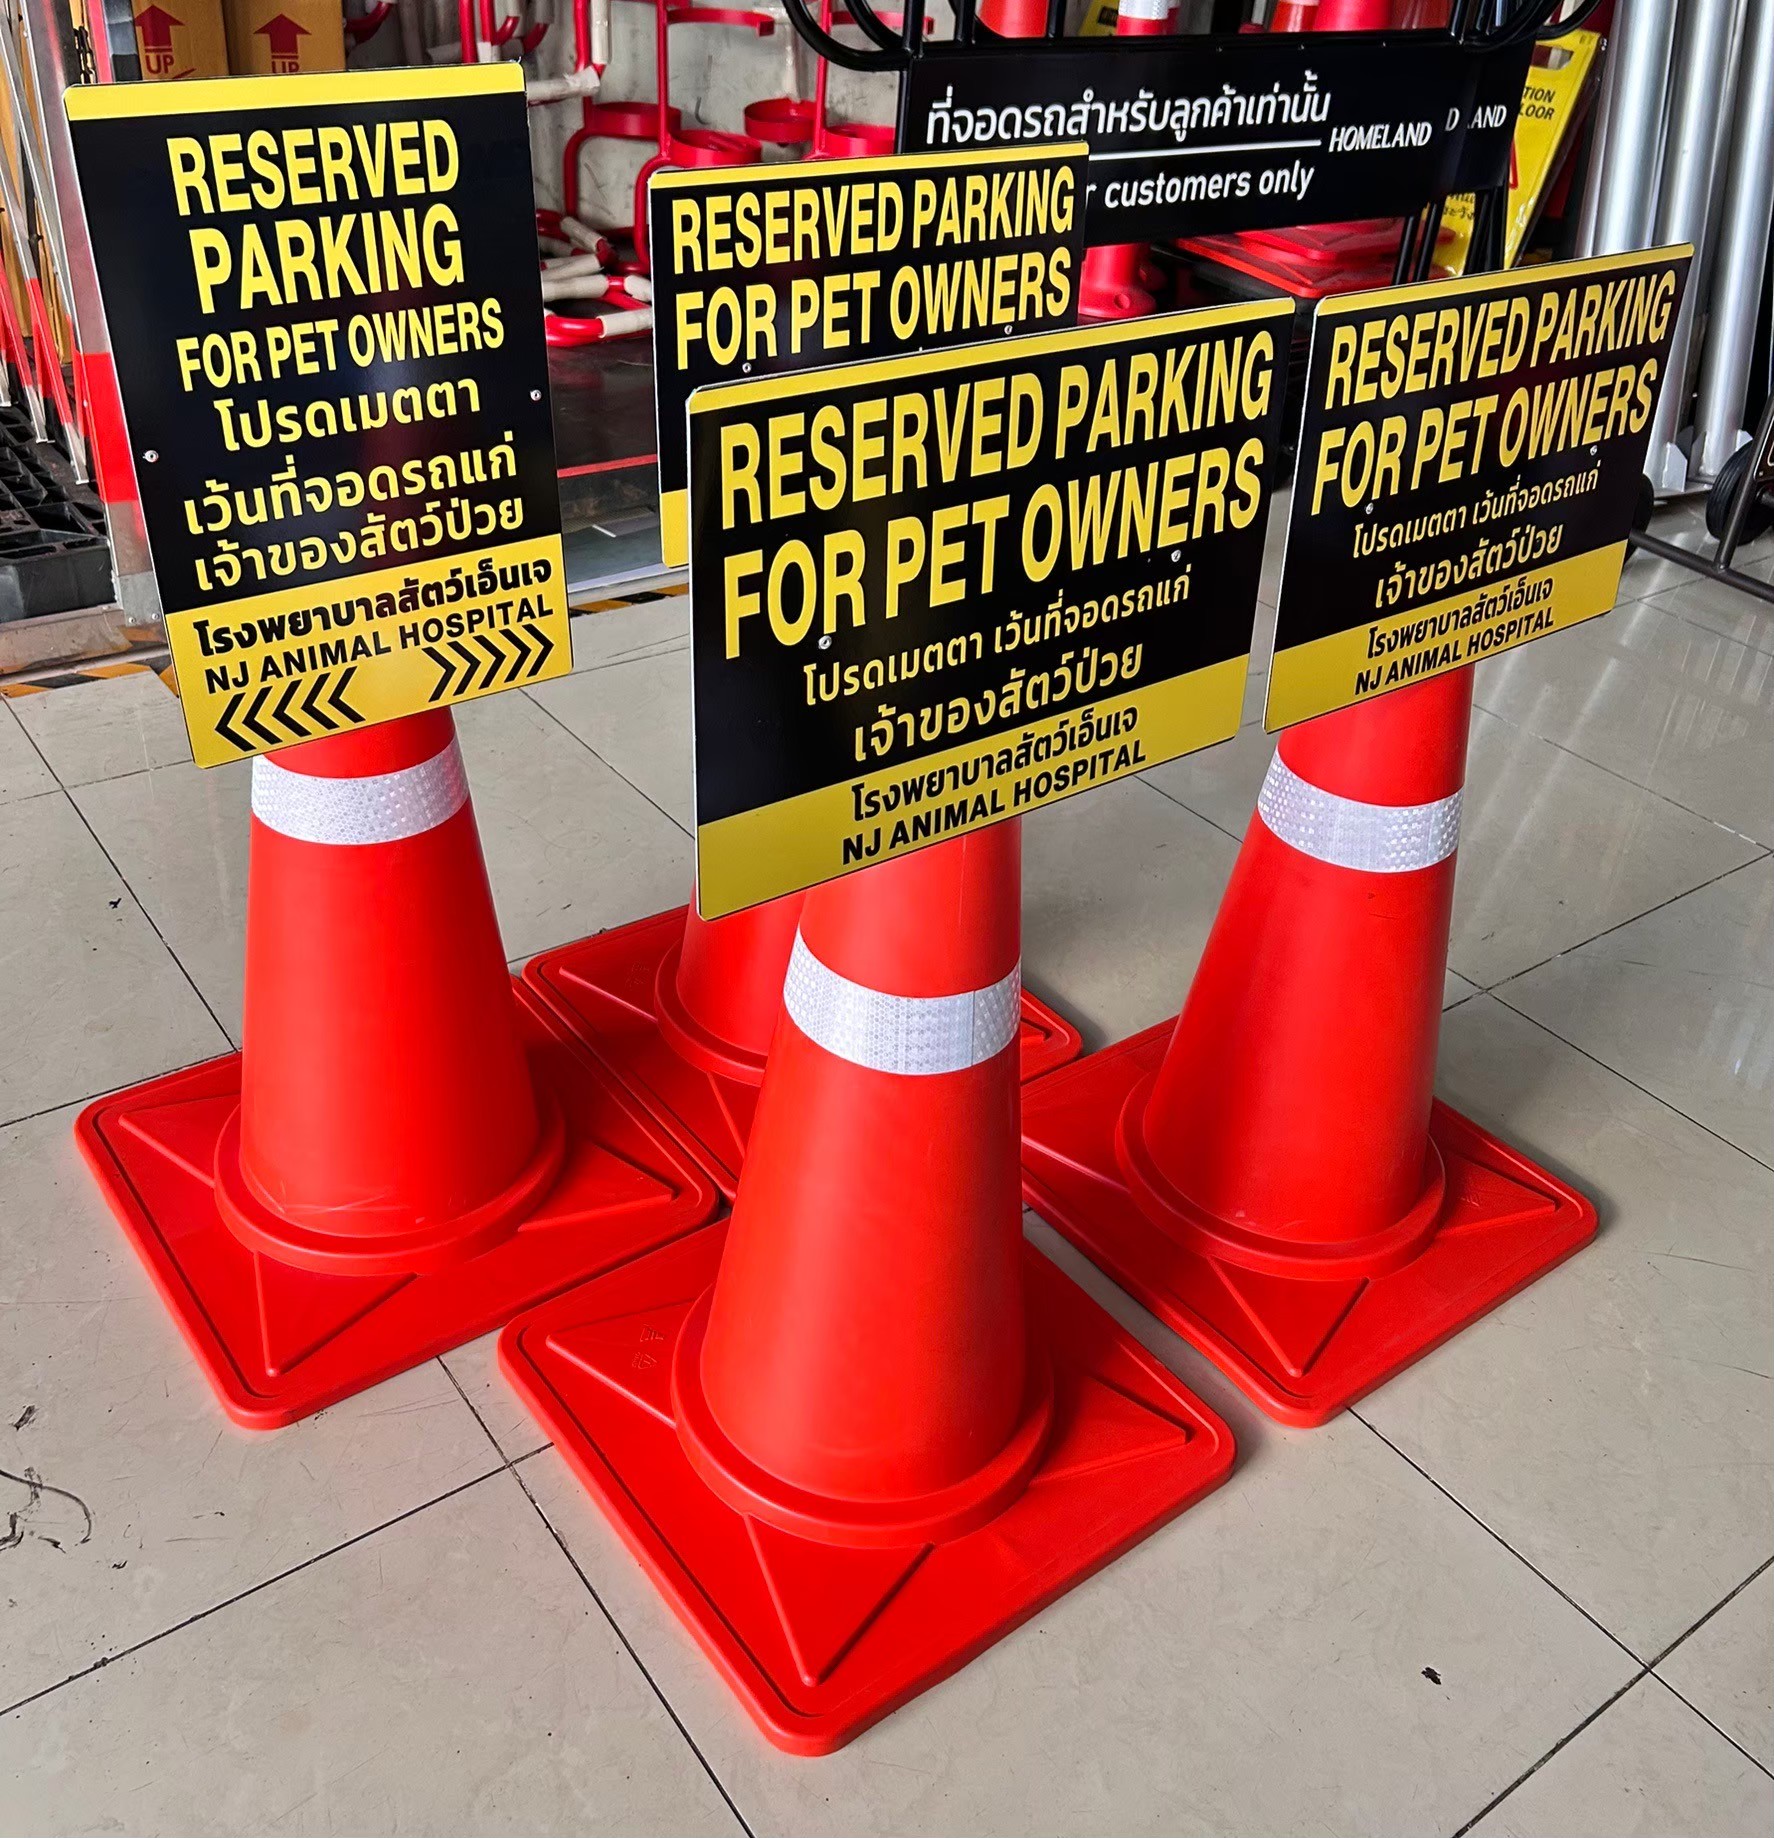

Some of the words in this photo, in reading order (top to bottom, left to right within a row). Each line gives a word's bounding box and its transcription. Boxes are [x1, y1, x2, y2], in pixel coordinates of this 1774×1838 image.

[145, 54, 175, 74] UP
[926, 69, 1331, 145] ที่จอดรถสำหรับลูกค้าเท่านั้น
[1518, 102, 1555, 120] LOOR
[1521, 86, 1556, 102] TION
[167, 119, 459, 216] RESERVED
[1104, 171, 1251, 208] customers
[1258, 160, 1315, 201] only
[1328, 121, 1432, 152] HOMELAND
[189, 203, 464, 314] PARKING
[672, 181, 903, 275] RESERVED
[913, 165, 1075, 248] PARKING
[177, 324, 262, 391] FOR
[266, 319, 339, 379] PET
[348, 298, 504, 367] OWNERS
[676, 283, 777, 370] FOR
[790, 270, 880, 354] PET
[890, 246, 1071, 340] OWNERS
[1325, 296, 1530, 410] RESERVED
[1531, 269, 1676, 373] PARKING
[214, 378, 480, 452] โปรดเมตตา
[720, 372, 1043, 530] RESERVED
[1055, 330, 1274, 459] PARKING
[1311, 415, 1407, 516] FOR
[1411, 395, 1499, 490] PET
[1500, 358, 1658, 468] OWNERS
[183, 431, 517, 535] เว้นที่จอดรถแก่
[1352, 506, 1467, 558] โปรดเมตตา
[1473, 460, 1601, 525] เว้นที่จอดรถแก่
[195, 497, 524, 591] เจ้าของสัตว์ป่วย
[724, 529, 866, 660] FOR
[885, 496, 1009, 619] PET
[1020, 437, 1264, 583] OWNERS
[1375, 523, 1563, 608] เจ้าของสัตว์ป่วย
[193, 557, 552, 656] โรงพยาบาลสัตว์เอ็นเจ
[205, 660, 249, 694] NJ
[260, 631, 391, 682] ANIMAL
[400, 595, 554, 648] HOSPITAL
[804, 630, 982, 705] โปรดเมตตา
[994, 563, 1191, 654] เว้นที่จอดรถแก่
[1355, 666, 1382, 696] NJ
[1385, 641, 1463, 686] ANIMAL
[1467, 606, 1555, 657] HOSPITAL
[1368, 577, 1554, 659] โรงพยาบาลสัตว์เอ็นเจ
[855, 643, 1143, 762] เจ้าของสัตว์ป่วย
[842, 822, 886, 864] NJ
[890, 791, 1005, 848] ANIMAL
[1013, 739, 1146, 808] HOSPITAL
[851, 705, 1138, 821] โรงพยาบาลสัตว์เอ็นเจ
